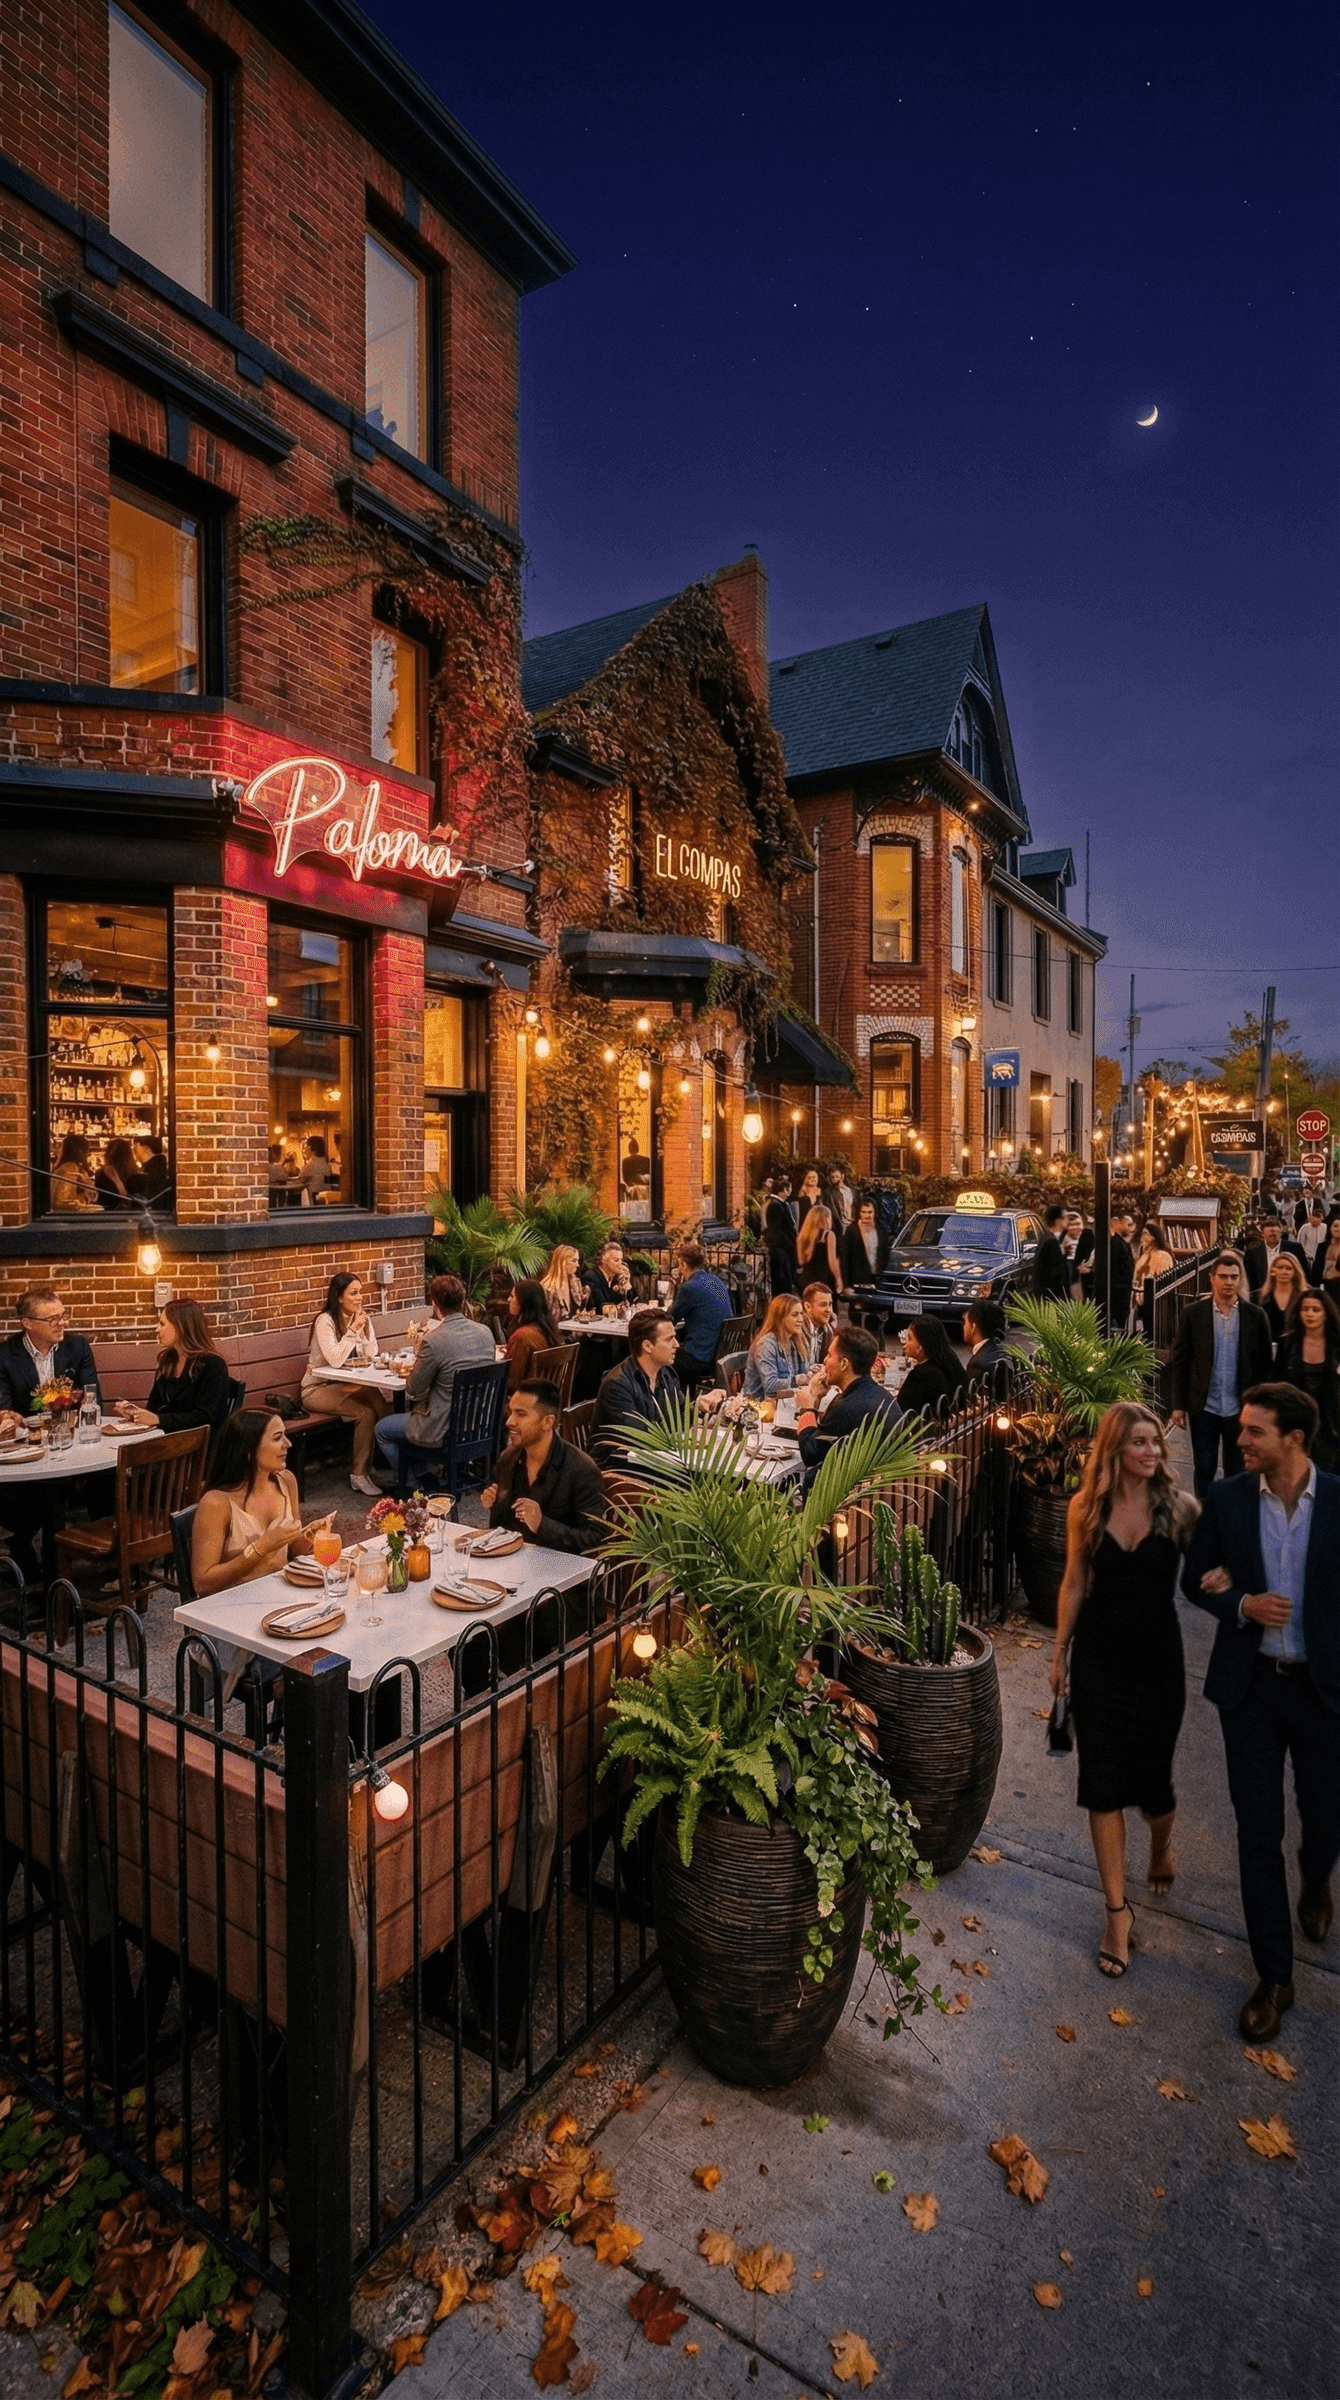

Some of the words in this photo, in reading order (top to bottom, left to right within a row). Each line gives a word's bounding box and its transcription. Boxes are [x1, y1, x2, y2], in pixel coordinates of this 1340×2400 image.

[245, 756, 462, 882] Paloma
[656, 833, 678, 880] EL
[680, 843, 741, 898] COMPAS
[1299, 1120, 1327, 1132] STOP
